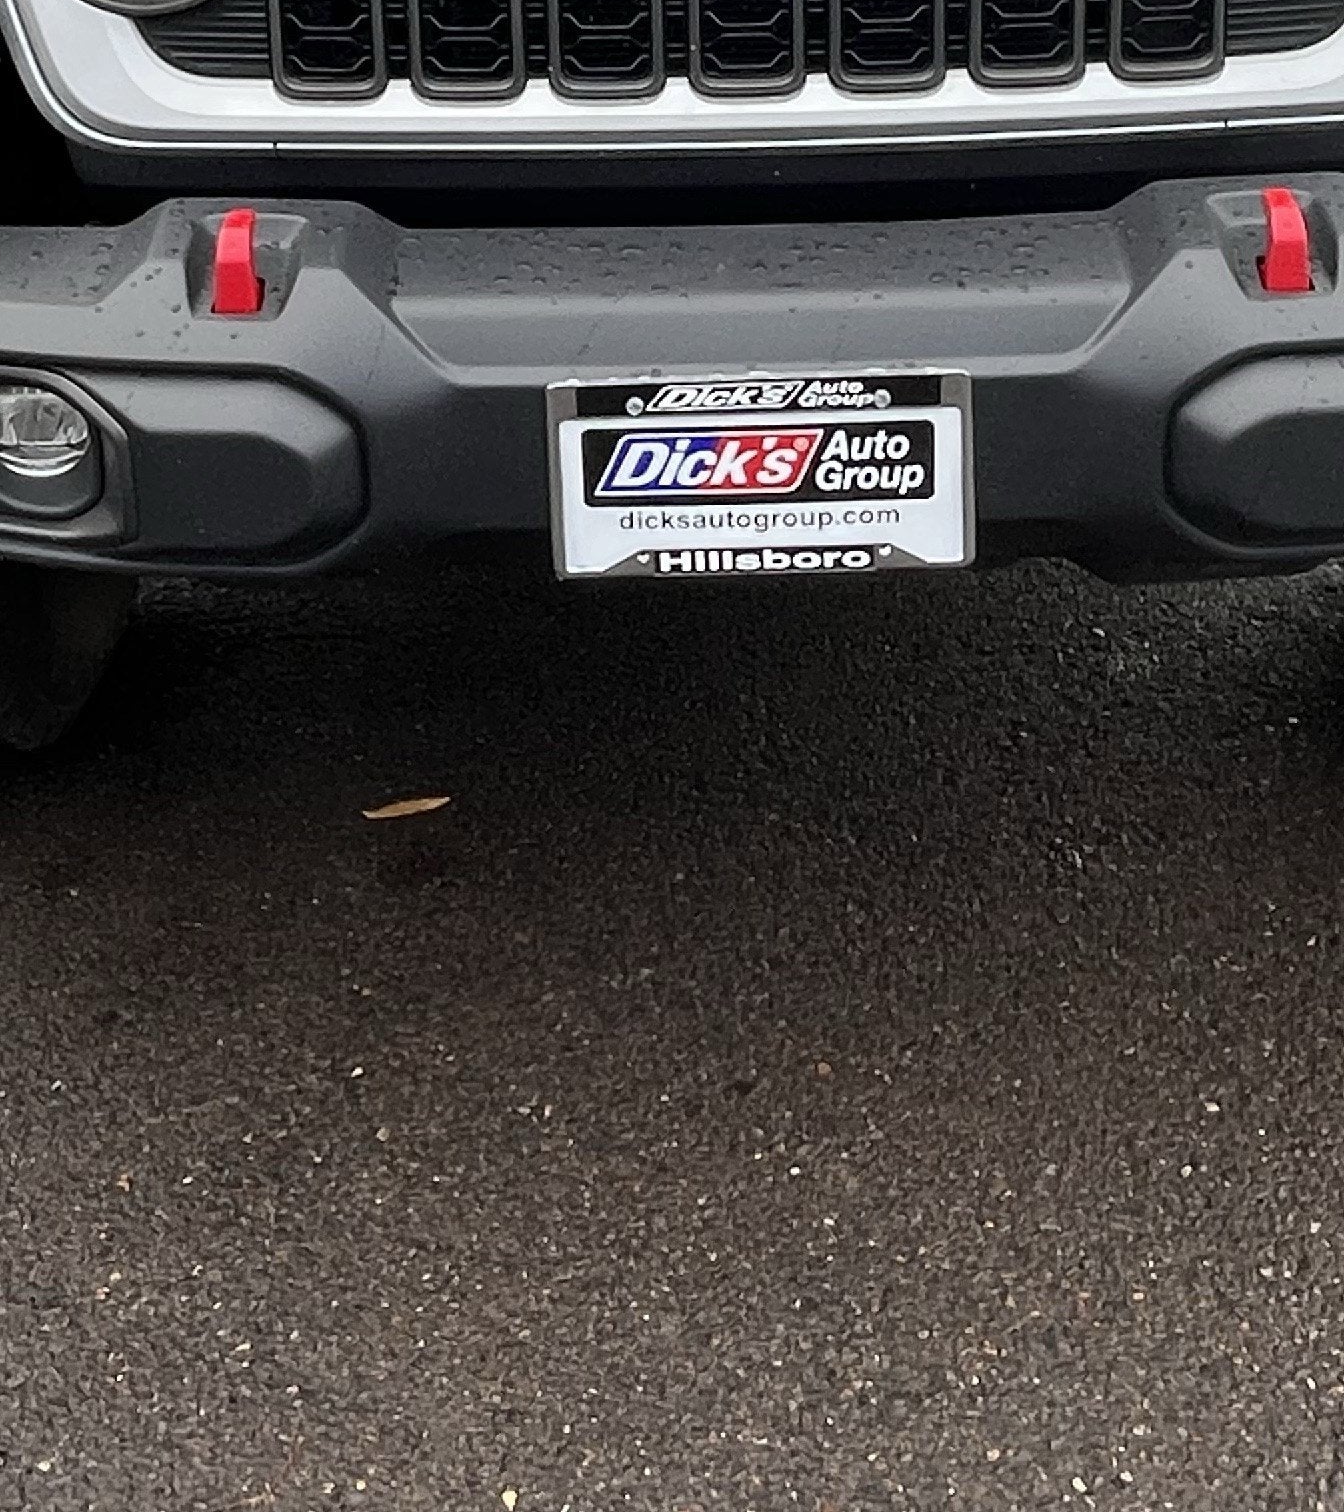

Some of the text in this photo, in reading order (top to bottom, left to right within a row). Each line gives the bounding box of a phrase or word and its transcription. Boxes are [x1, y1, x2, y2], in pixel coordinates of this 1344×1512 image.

[806, 380, 864, 395] Auto
[797, 392, 876, 409] Group
[820, 429, 910, 462] Auto
[610, 436, 799, 488] Dick's
[814, 461, 925, 495] Group
[619, 508, 902, 533] dicksautogroup.com
[658, 548, 873, 573] Hillsboro
